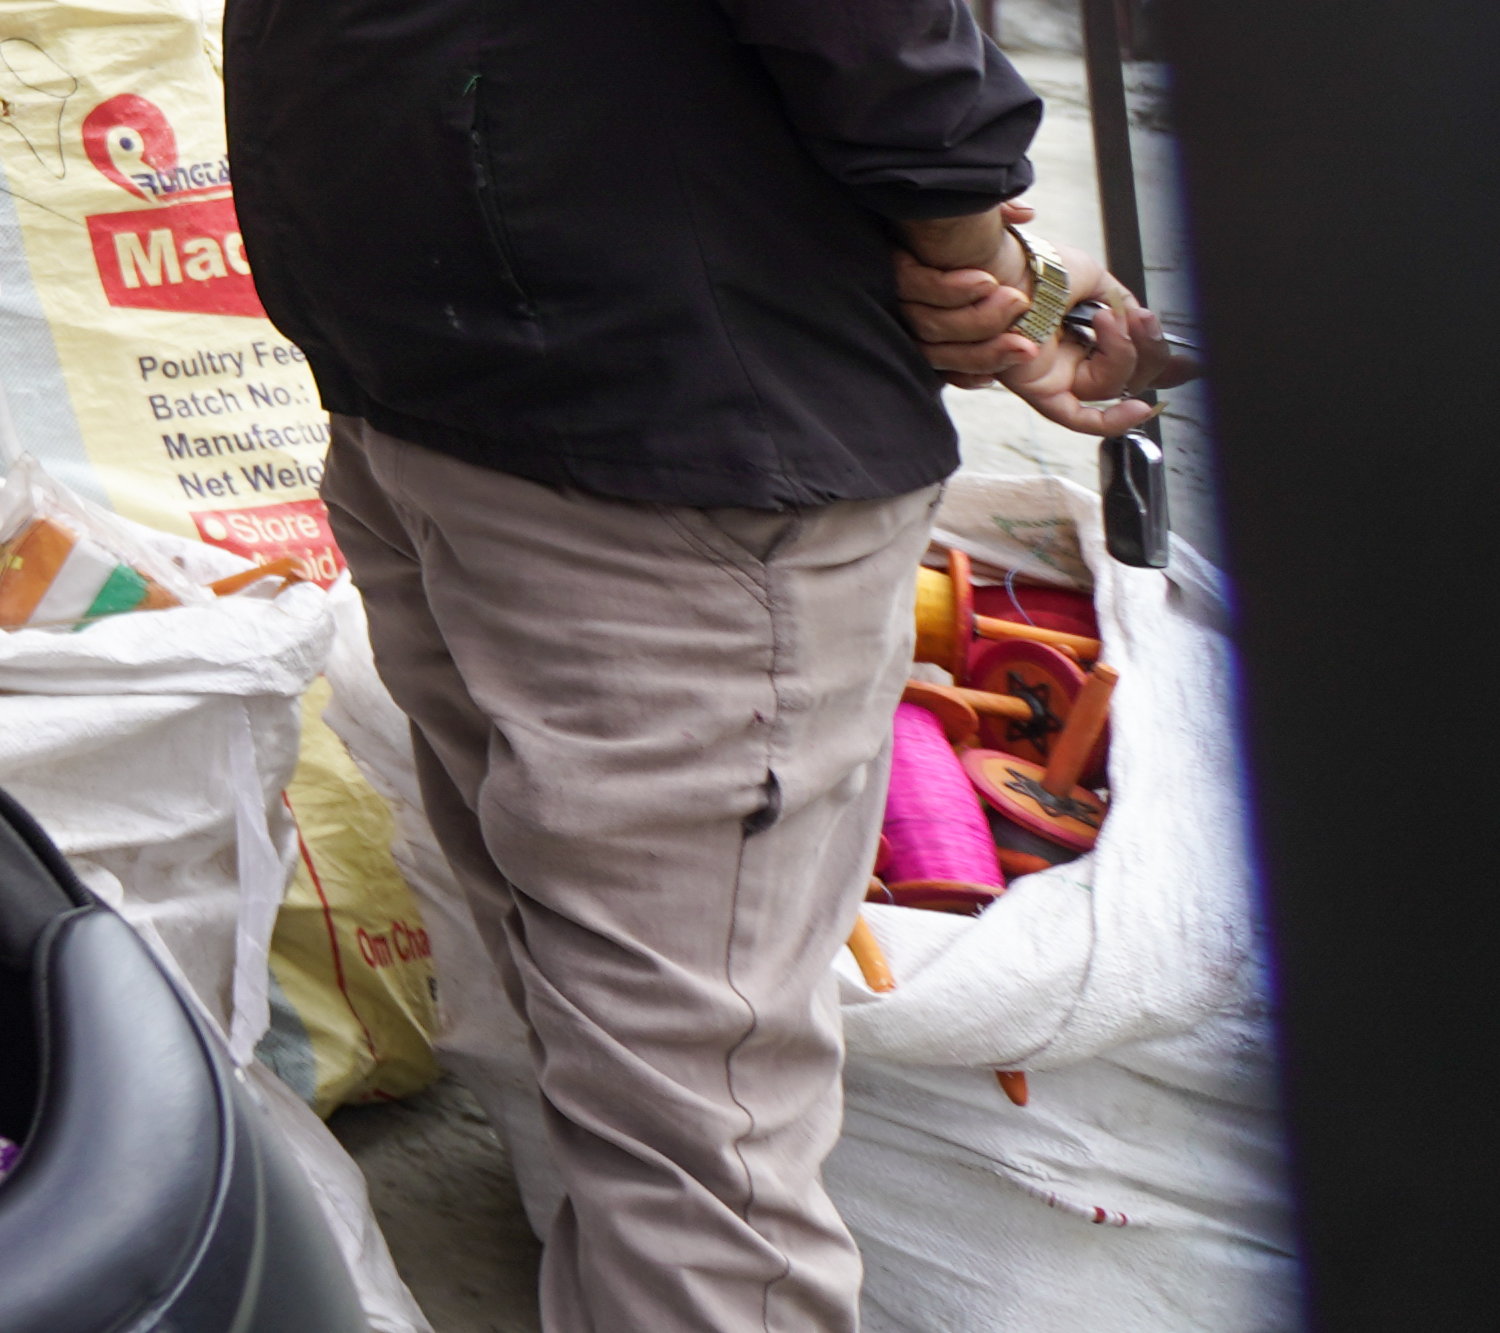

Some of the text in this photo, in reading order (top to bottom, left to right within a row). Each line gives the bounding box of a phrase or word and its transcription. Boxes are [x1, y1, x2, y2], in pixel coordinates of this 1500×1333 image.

[137, 349, 245, 383] Poultry
[148, 382, 311, 422] Batch No.:
[177, 470, 240, 500] Net
[226, 510, 322, 545] Store
